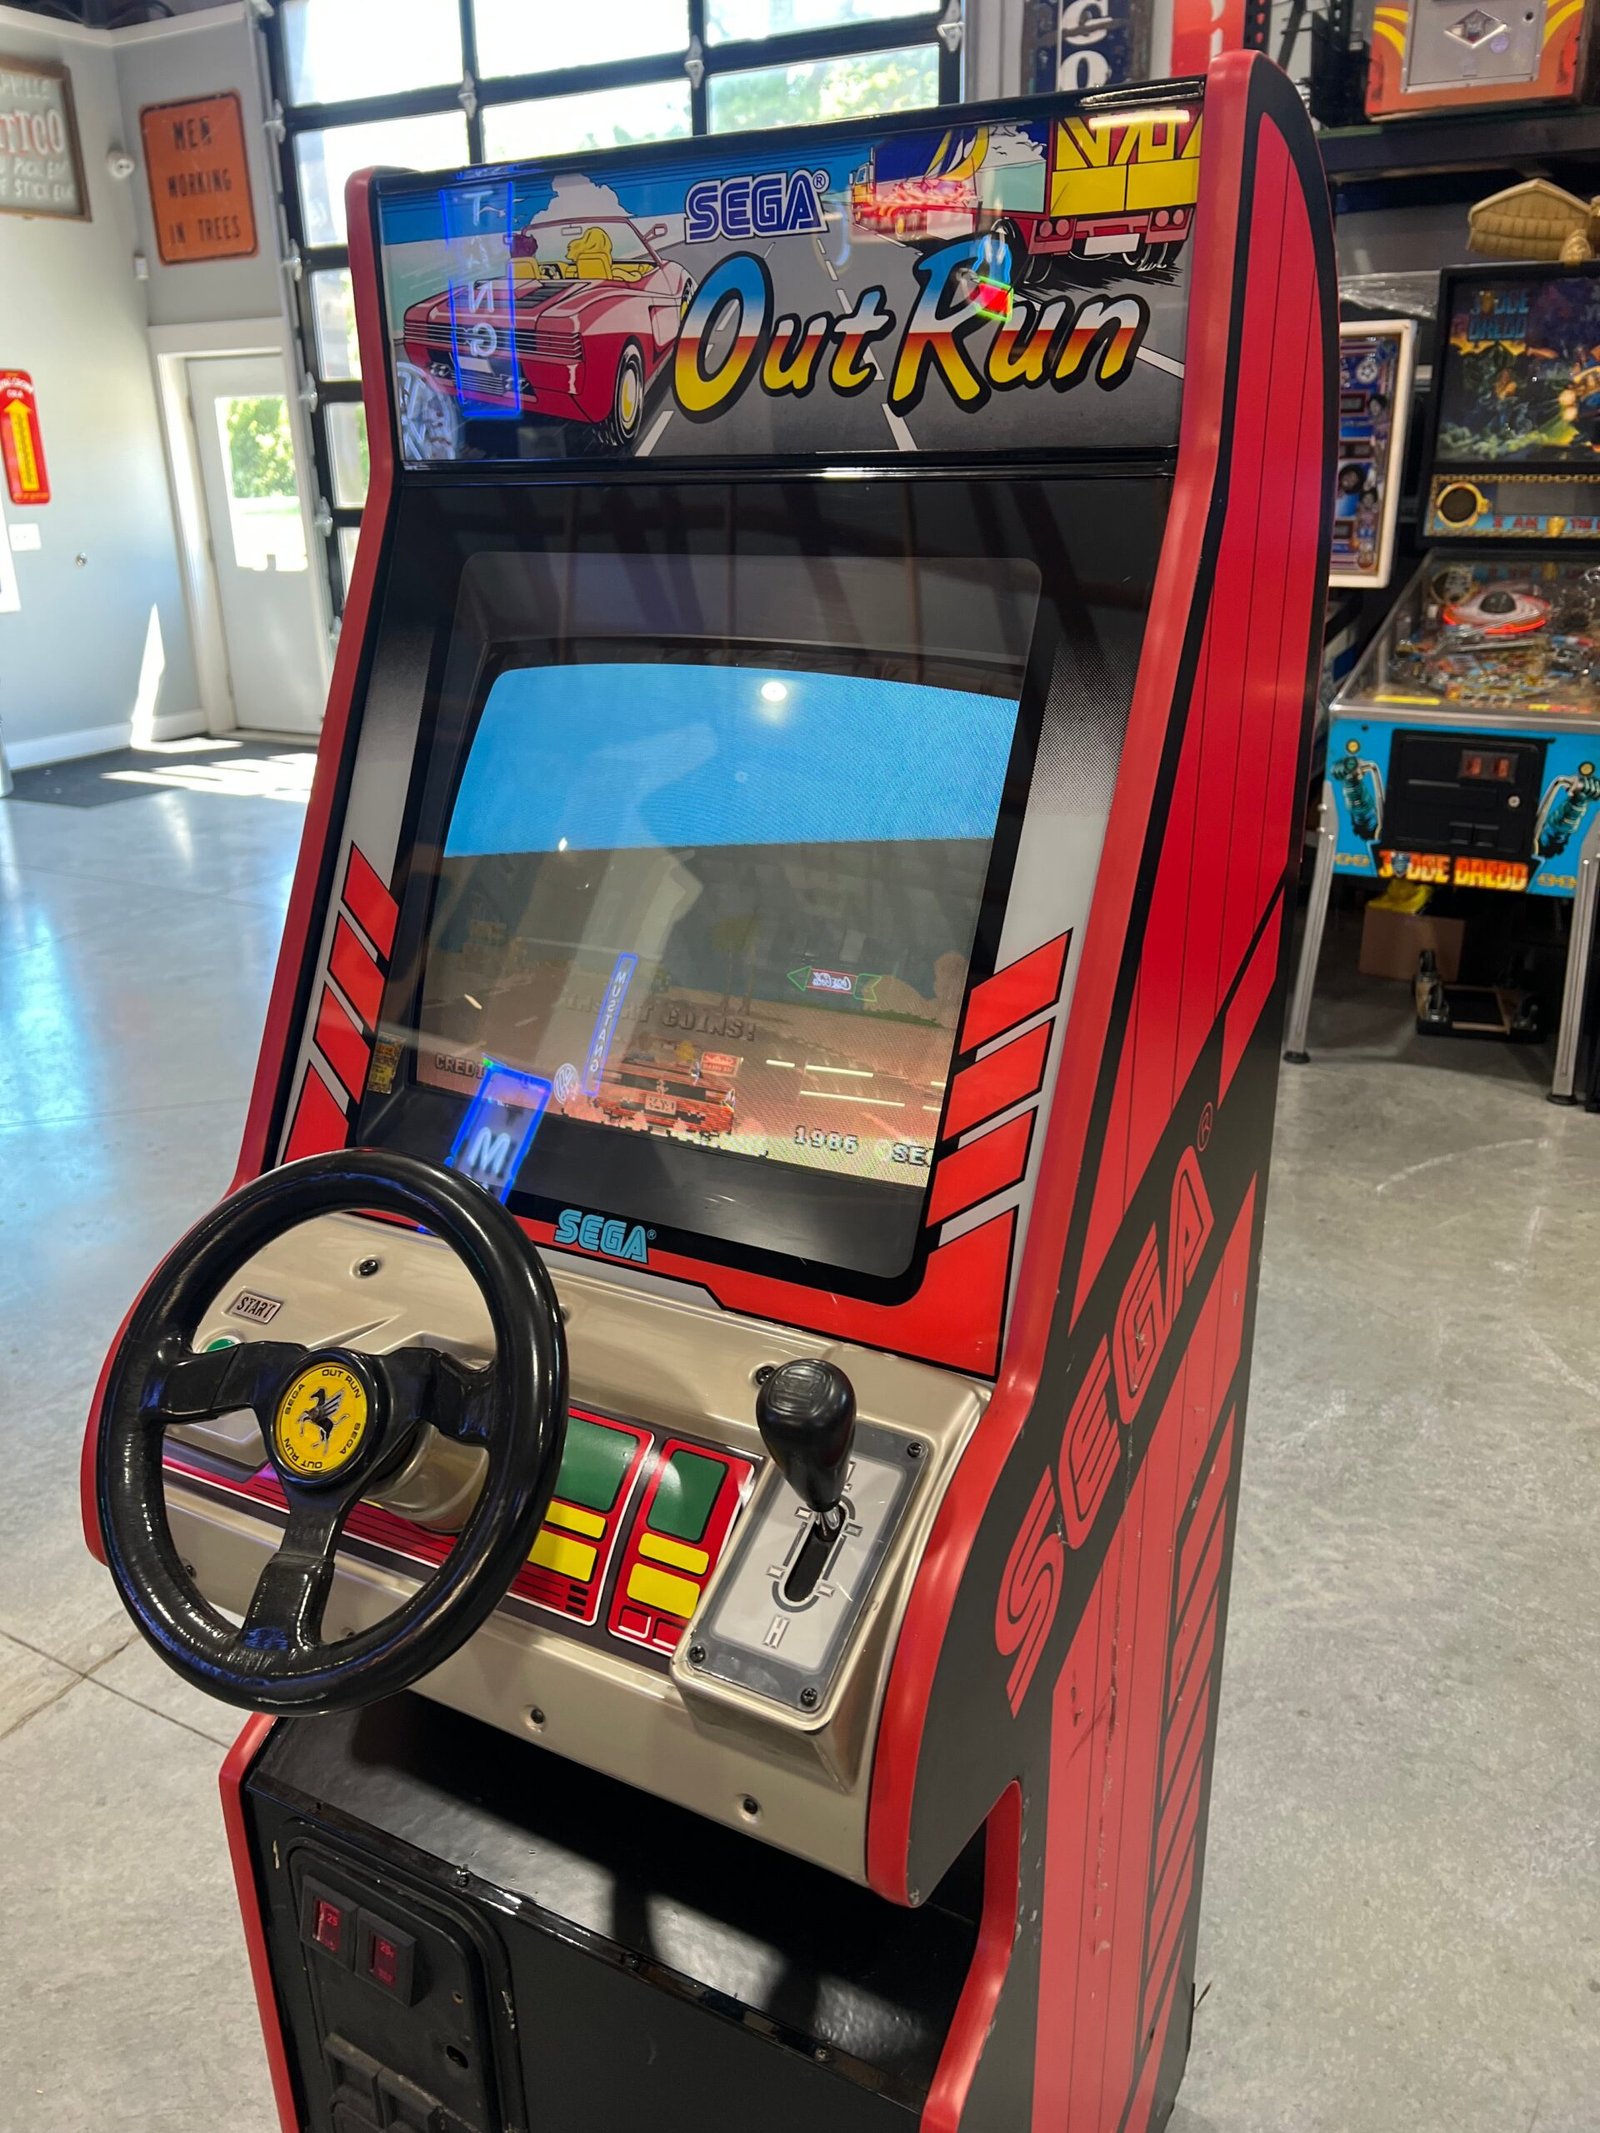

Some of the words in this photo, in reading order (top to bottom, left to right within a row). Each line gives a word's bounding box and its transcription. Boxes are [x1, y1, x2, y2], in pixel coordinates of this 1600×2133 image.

[0, 108, 64, 154] TTOO
[173, 116, 212, 150] MEN
[168, 168, 232, 198] WORKING
[170, 222, 186, 246] IN
[198, 215, 241, 242] TREES
[1454, 856, 1528, 892] DREDD
[662, 1004, 757, 1043] COINS!
[795, 1124, 859, 1155] 1986
[891, 1141, 934, 1168] SE
[236, 1296, 276, 1318] START
[284, 1383, 305, 1415] SEGA
[321, 1368, 344, 1377] OUT
[345, 1375, 361, 1399] RUN
[283, 1438, 300, 1462] RUN
[339, 1422, 361, 1455] SEGA
[301, 1459, 323, 1469] OUT
